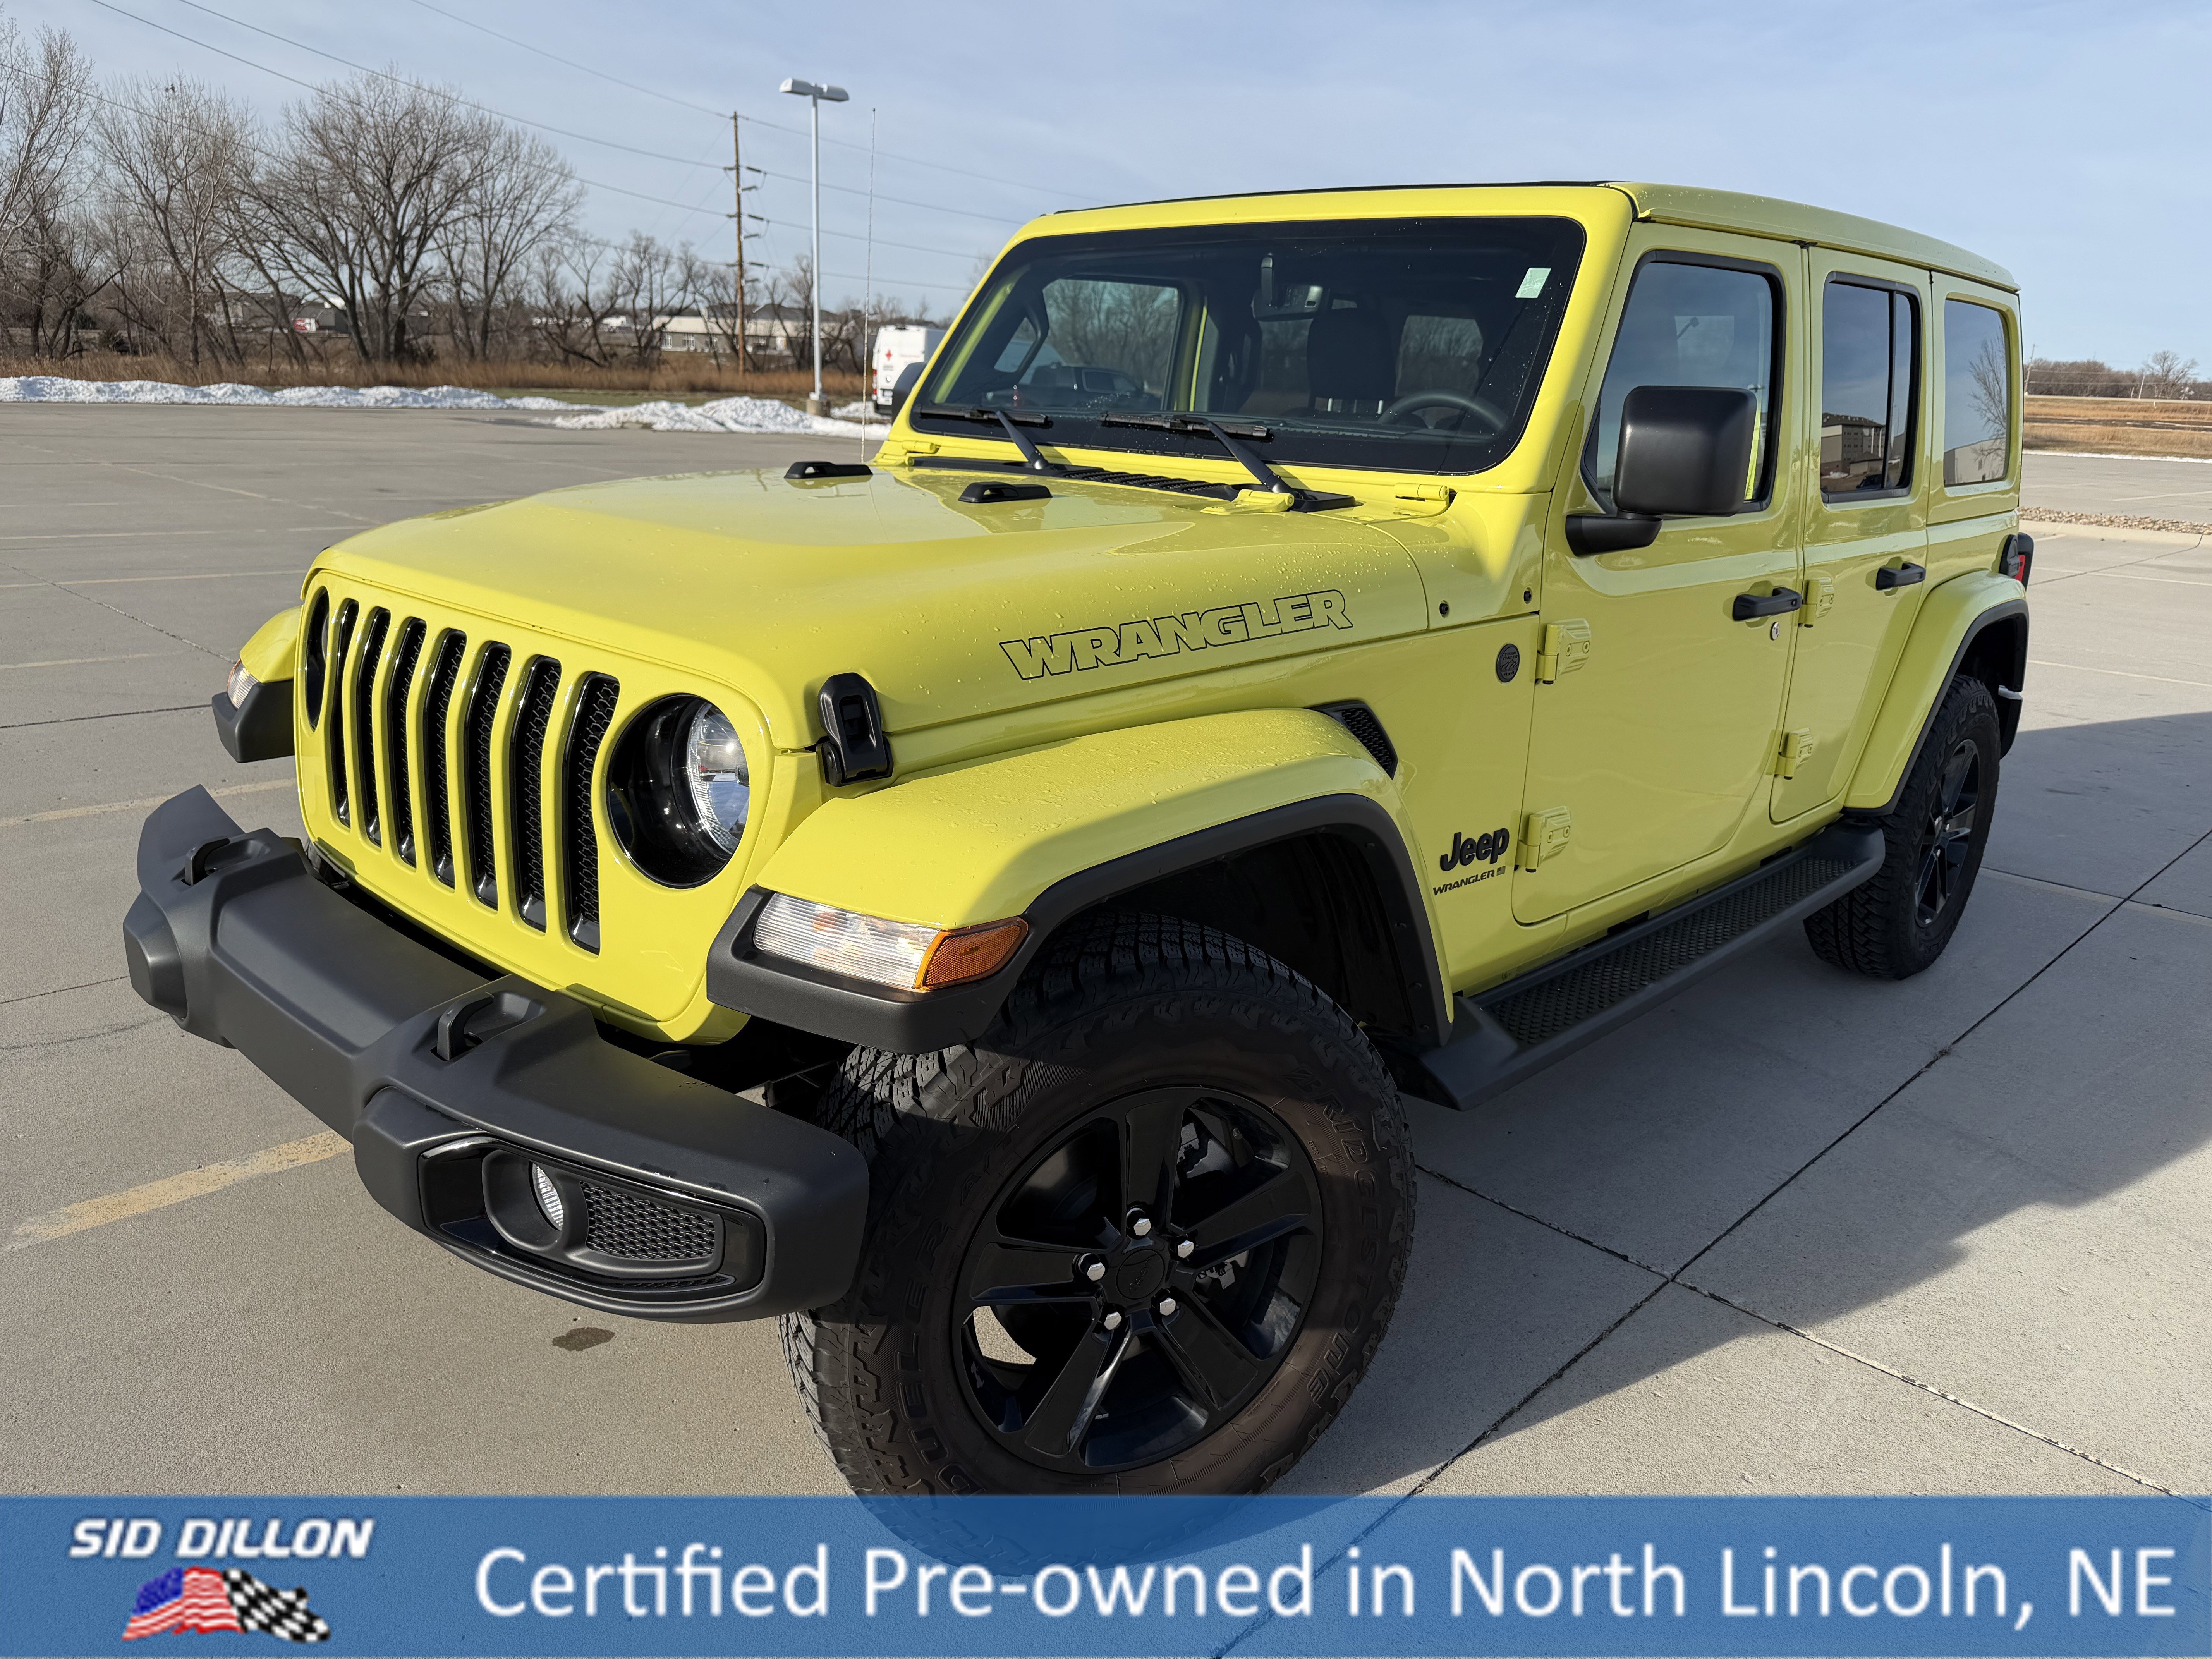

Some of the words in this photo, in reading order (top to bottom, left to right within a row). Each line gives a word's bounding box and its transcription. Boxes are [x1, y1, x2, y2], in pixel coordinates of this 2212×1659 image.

[999, 589, 1354, 680] WRANGLER
[1433, 869, 1495, 896] WRANGLER
[1440, 828, 1510, 871] Jeep
[1282, 1064, 1382, 1408] BRIDGESTONE
